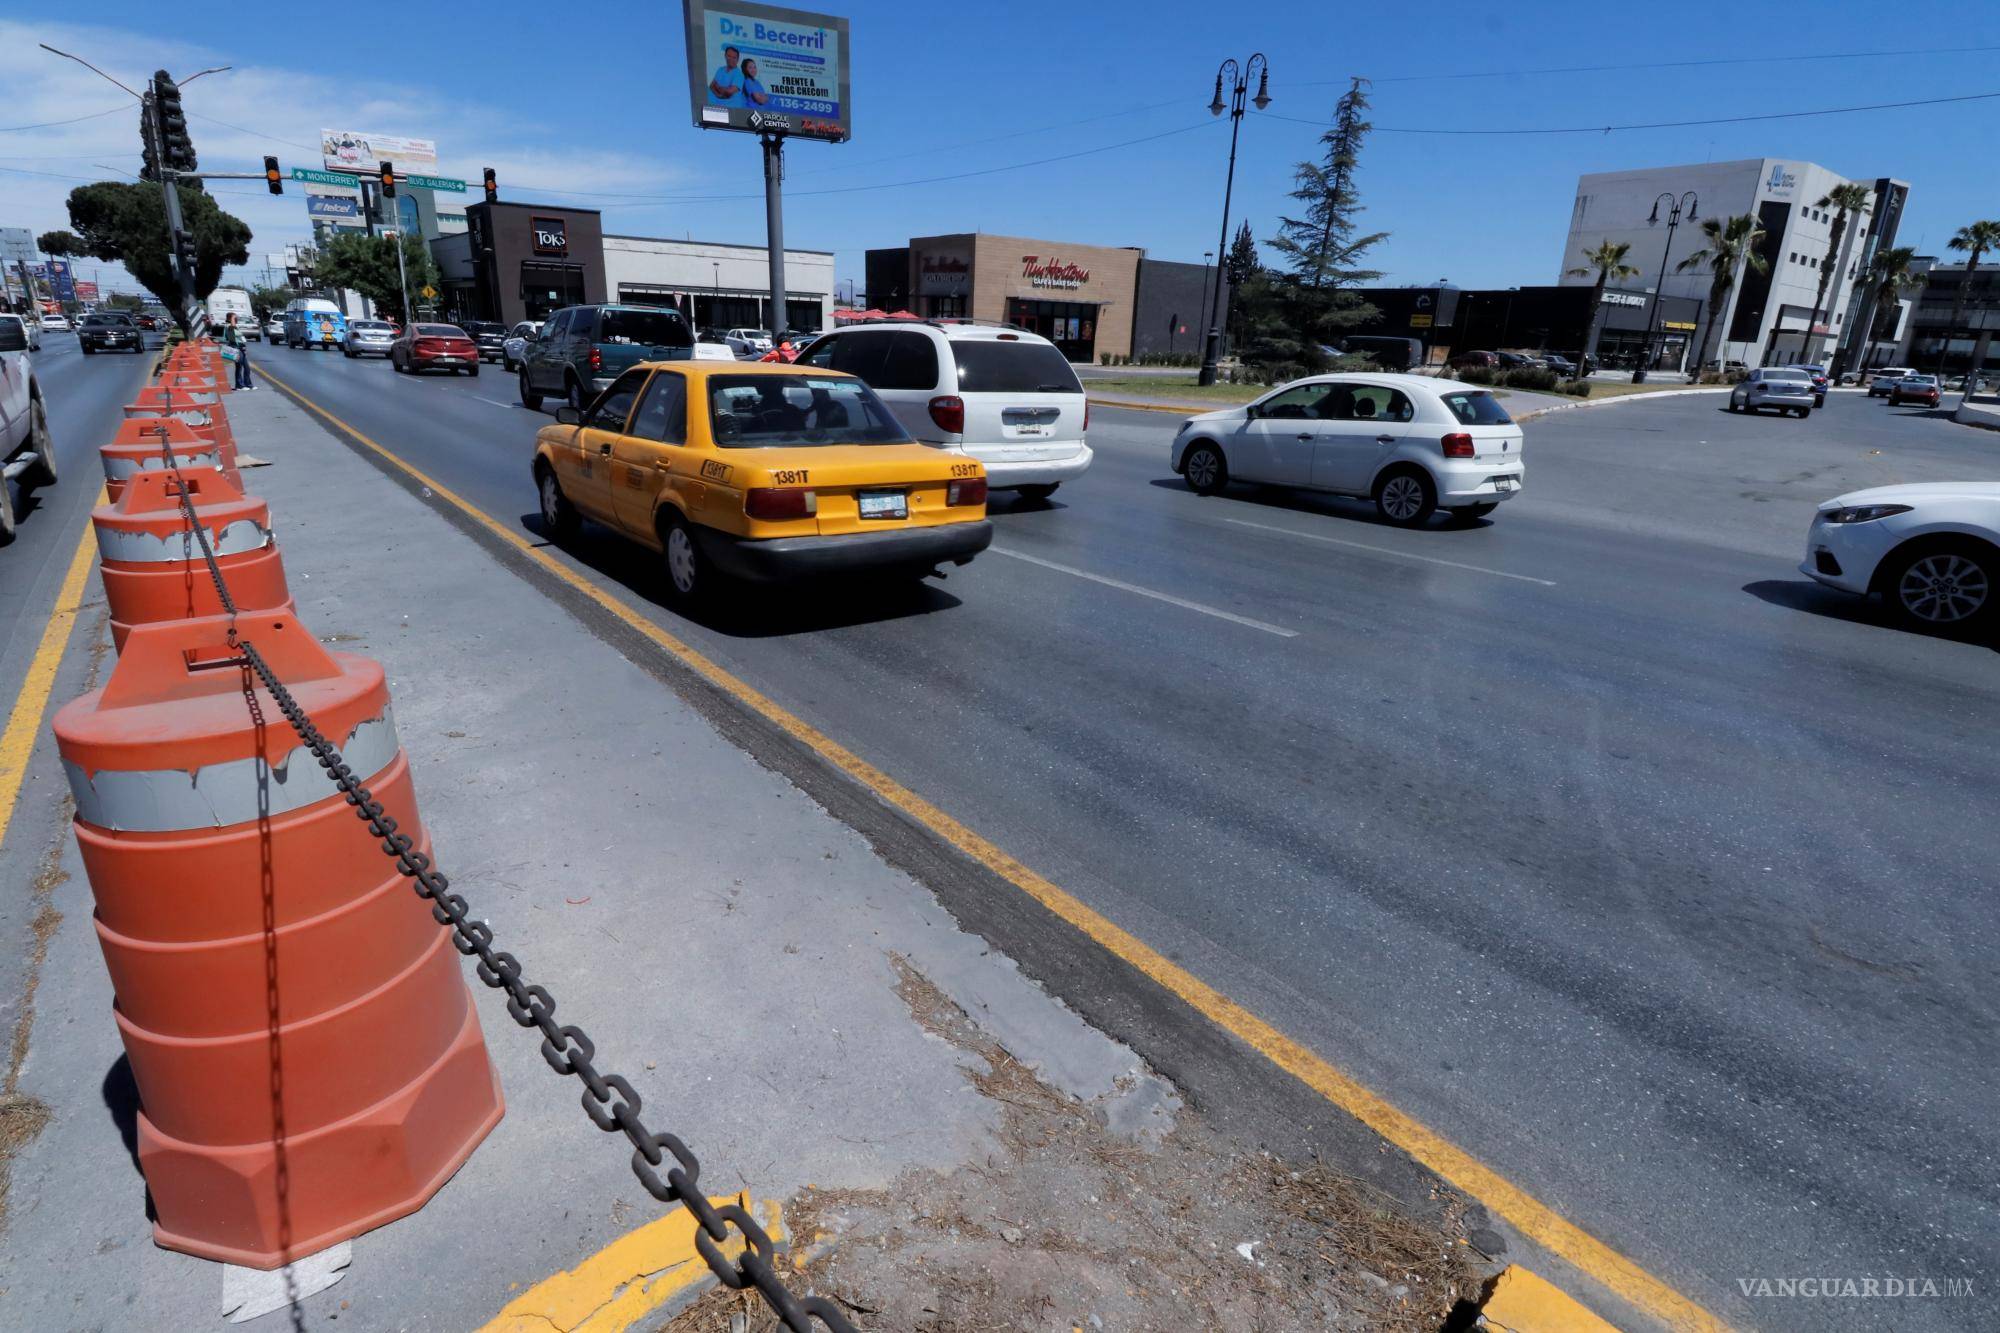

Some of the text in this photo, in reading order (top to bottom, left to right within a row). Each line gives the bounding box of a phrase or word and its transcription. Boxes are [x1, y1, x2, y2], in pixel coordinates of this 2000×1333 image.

[719, 17, 748, 38] Dr.
[754, 23, 824, 49] Becerril
[782, 76, 815, 87] FRENTE A
[770, 84, 795, 95] TACOS
[779, 98, 833, 113] 136-2499
[763, 113, 789, 121] PARQUE
[307, 172, 356, 186] MONTERREY
[408, 176, 426, 186] BLVD.
[322, 203, 351, 213] telcel
[1022, 255, 1090, 283] Tim Hortons
[707, 461, 727, 478] 1381T
[950, 463, 979, 477] 1381T
[774, 469, 809, 485] 1381T
